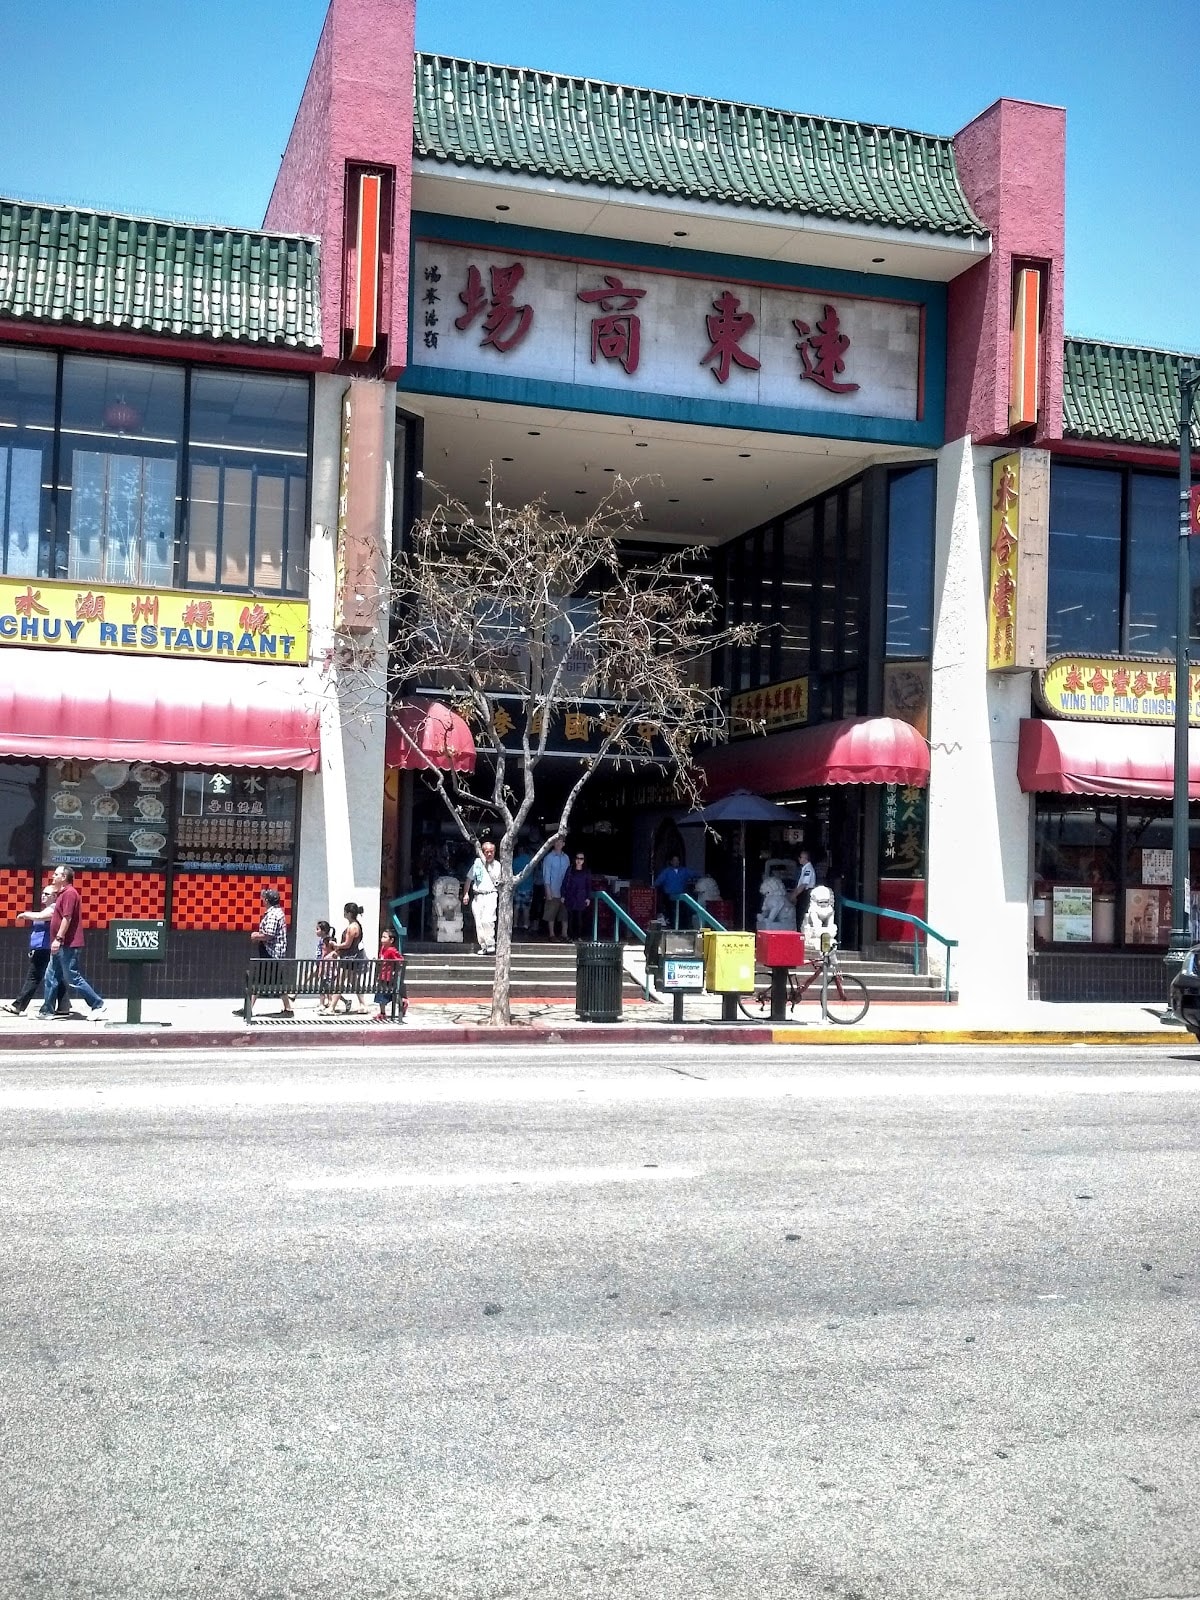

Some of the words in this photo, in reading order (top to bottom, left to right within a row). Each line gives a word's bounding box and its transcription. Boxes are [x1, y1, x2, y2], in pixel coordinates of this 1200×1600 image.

[0, 614, 85, 643] CHUY
[100, 622, 295, 657] RESTAURANT
[1060, 693, 1087, 710] WING
[1090, 694, 1110, 712] HOP
[1113, 696, 1139, 714] FUNG
[116, 930, 159, 938] DOWNTOWN
[116, 936, 159, 948] NEWS
[677, 963, 700, 971] Welcome
